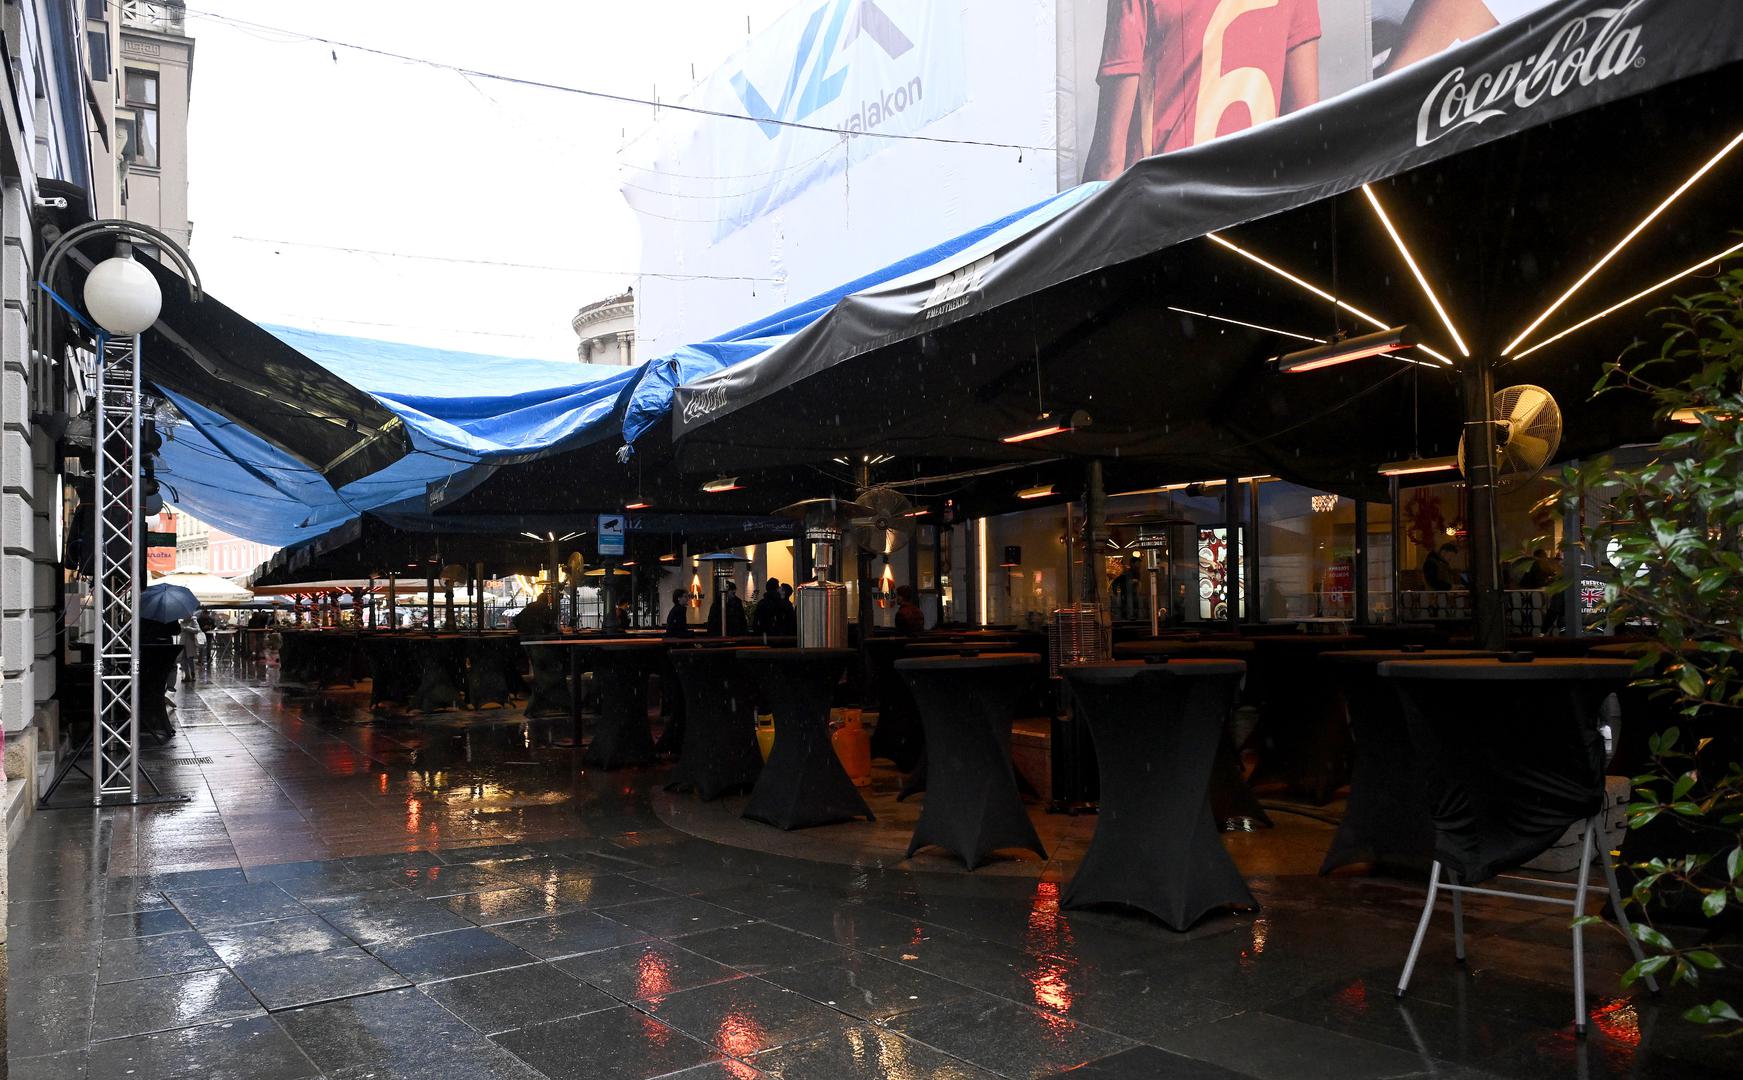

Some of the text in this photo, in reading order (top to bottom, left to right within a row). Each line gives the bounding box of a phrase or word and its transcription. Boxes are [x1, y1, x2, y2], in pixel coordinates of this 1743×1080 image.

[836, 76, 922, 143] valakon
[1193, 0, 1280, 147] 6
[1416, 0, 1643, 147] Coca-Cola
